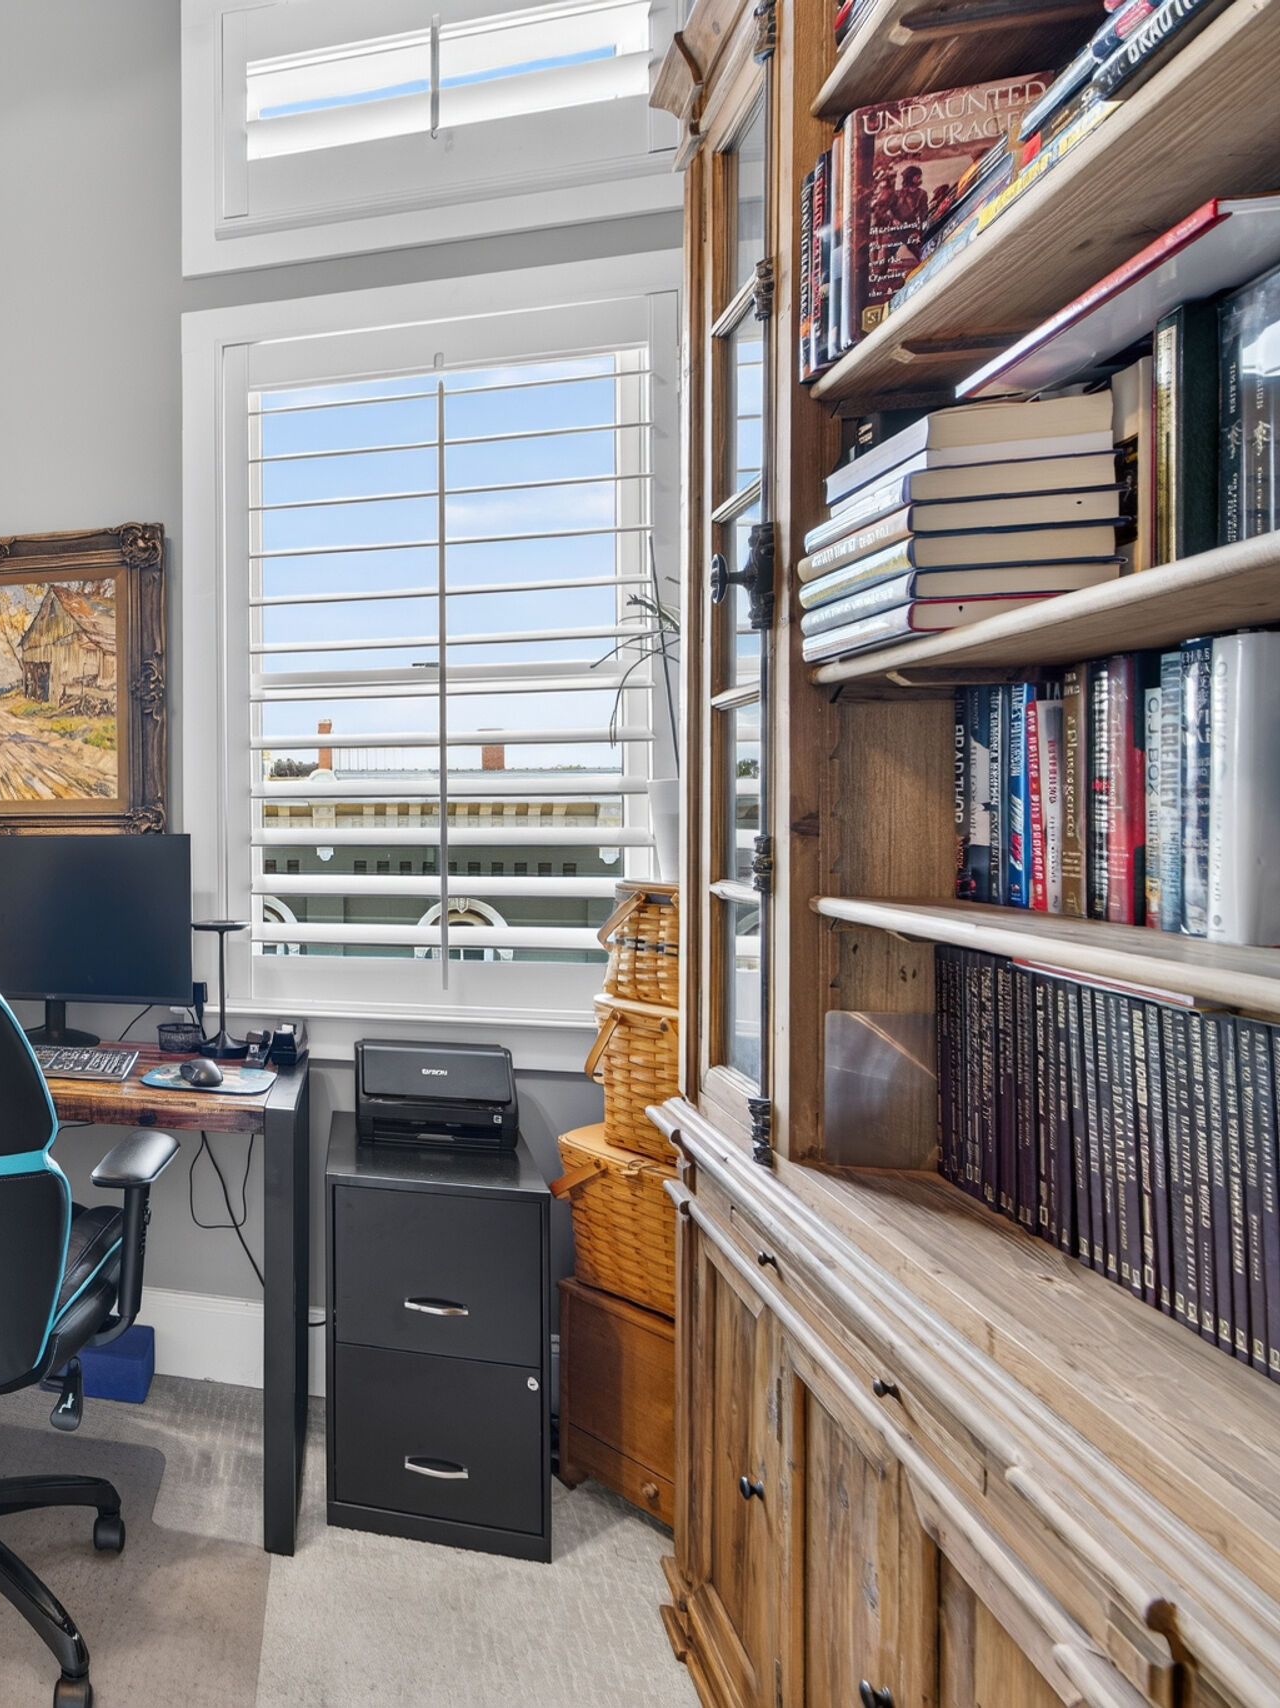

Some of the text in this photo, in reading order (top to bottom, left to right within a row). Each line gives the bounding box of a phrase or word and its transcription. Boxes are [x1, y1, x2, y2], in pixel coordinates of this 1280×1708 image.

[863, 81, 1047, 135] UNDAUNTED
[883, 111, 1022, 157] COURAGE
[1148, 749, 1159, 797] BOX
